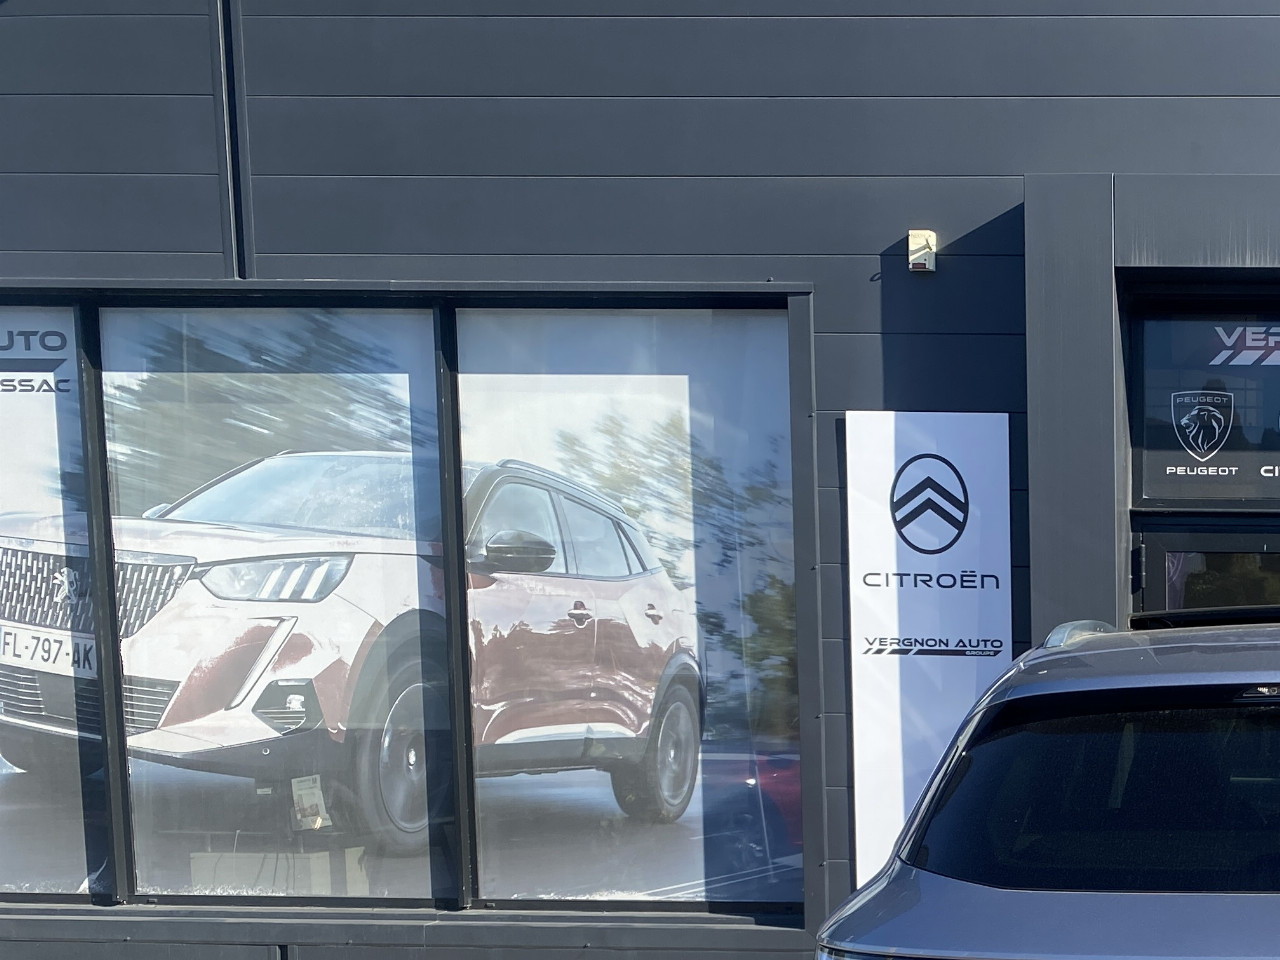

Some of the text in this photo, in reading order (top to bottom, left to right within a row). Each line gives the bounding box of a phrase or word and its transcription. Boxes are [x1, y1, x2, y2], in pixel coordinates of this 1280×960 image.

[1176, 396, 1229, 404] PEUGEOT
[1166, 466, 1239, 475] PEUGEOT
[864, 637, 1004, 648] VERGNON AUTO
[2, 630, 94, 671] FL-797-AK
